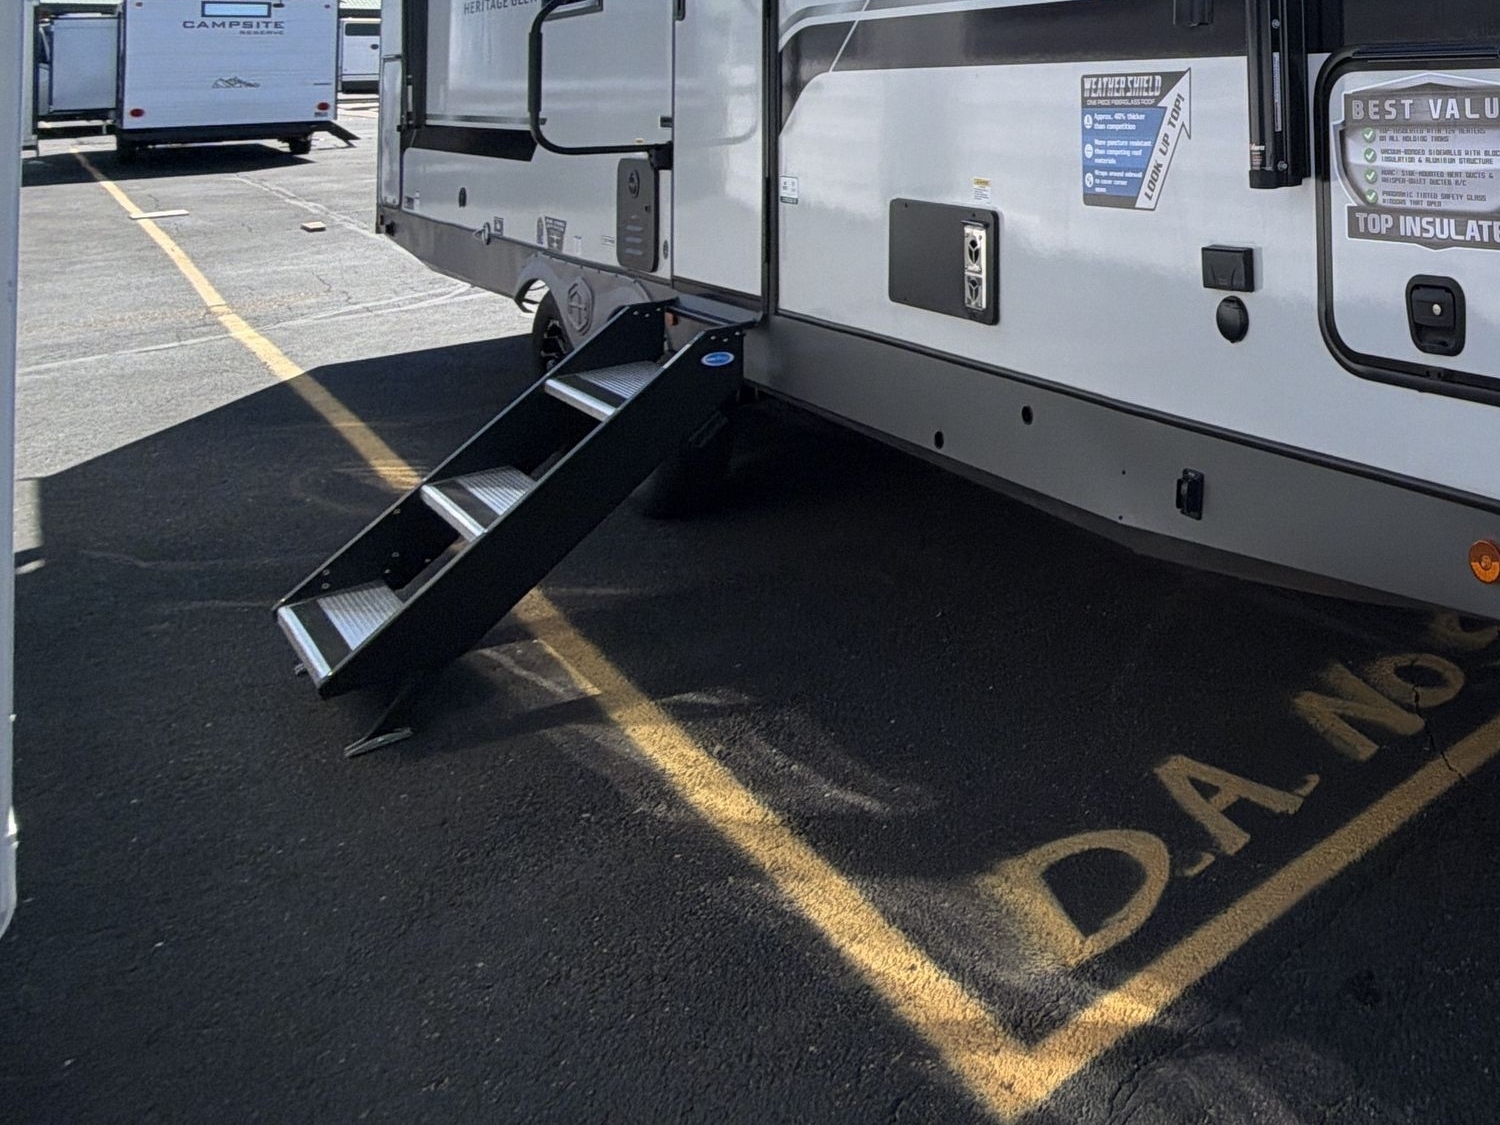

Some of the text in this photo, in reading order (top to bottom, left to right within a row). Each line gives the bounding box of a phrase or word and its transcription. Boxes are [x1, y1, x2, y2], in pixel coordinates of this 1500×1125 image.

[182, 20, 285, 29] CAMPSITE
[1351, 99, 1414, 120] BEST
[1144, 93, 1185, 201] LOOK UP TOP!
[1458, 157, 1494, 165] STRUCTURE
[1355, 212, 1394, 235] TOP
